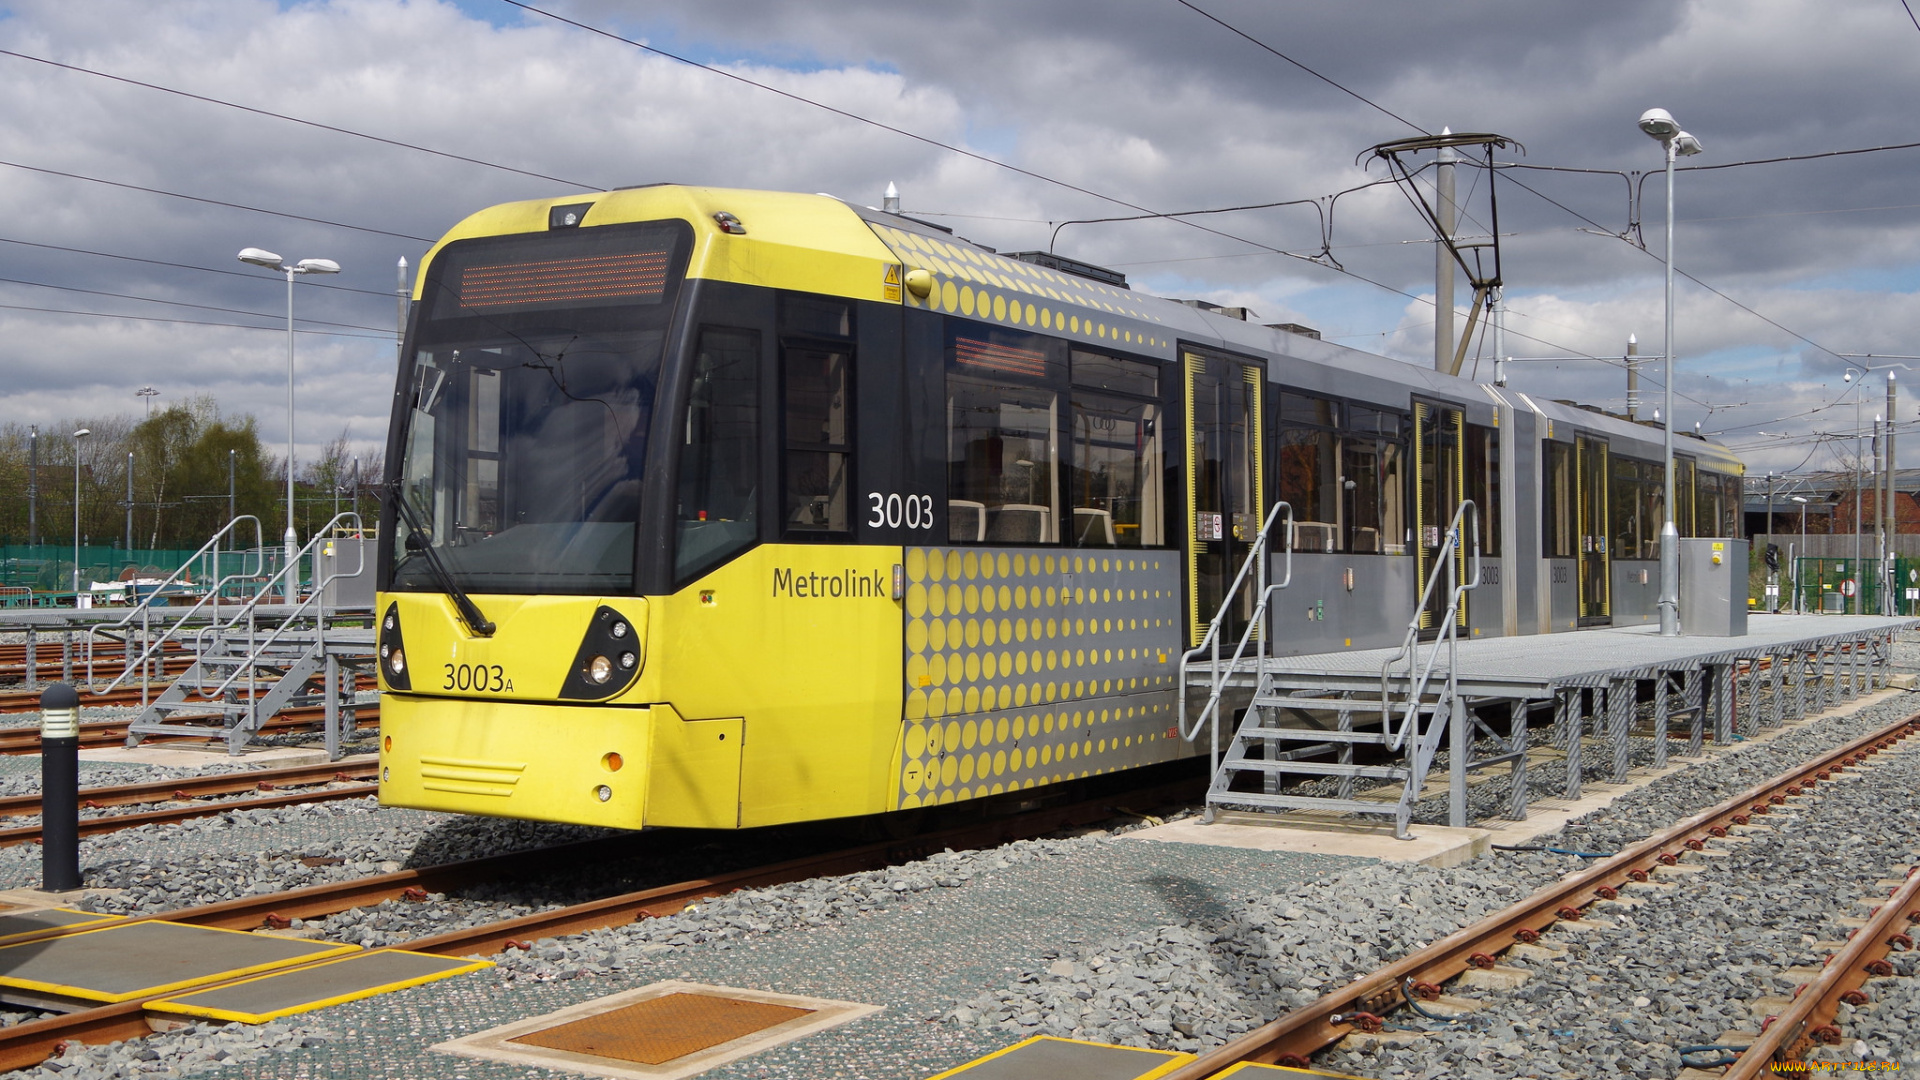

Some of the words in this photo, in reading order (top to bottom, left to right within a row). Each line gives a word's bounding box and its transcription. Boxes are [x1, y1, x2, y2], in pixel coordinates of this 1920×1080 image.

[868, 492, 934, 530] 3003
[772, 567, 886, 598] Metrolink
[1482, 566, 1499, 585] 3003
